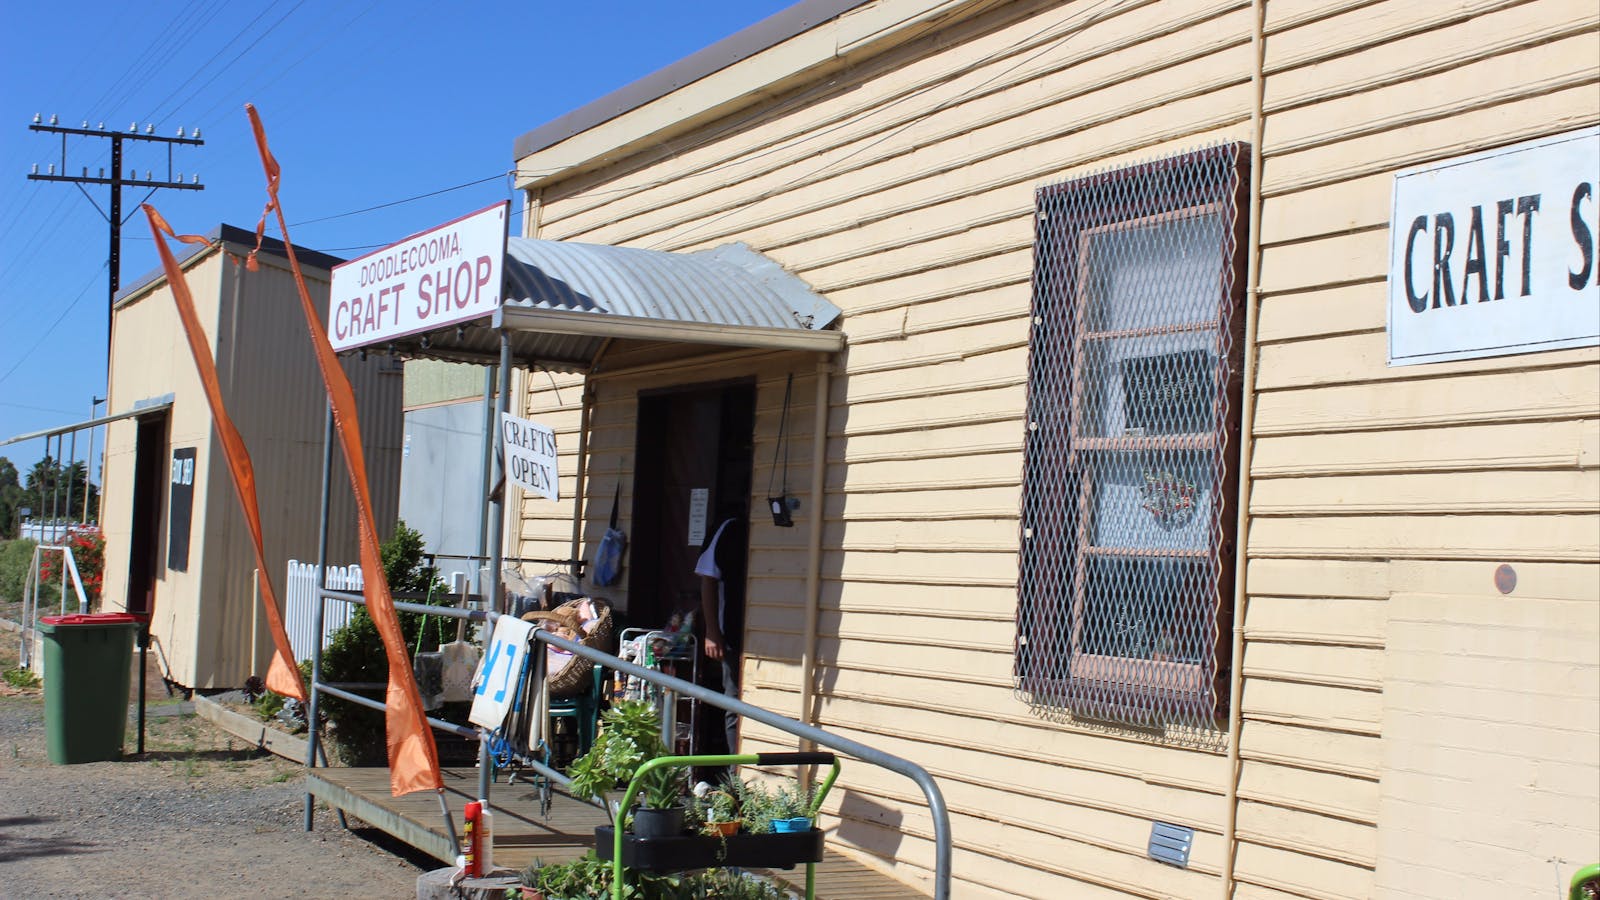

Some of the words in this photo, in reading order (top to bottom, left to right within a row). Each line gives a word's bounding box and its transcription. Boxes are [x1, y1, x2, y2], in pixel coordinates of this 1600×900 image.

[360, 231, 460, 288] DOODLECOOMA
[1404, 193, 1542, 314] CRAFT
[1567, 181, 1600, 290] S
[335, 282, 405, 341] CRAFT
[416, 255, 492, 320] SHOP
[504, 420, 555, 458] CRAFTS
[512, 454, 551, 492] OPEN
